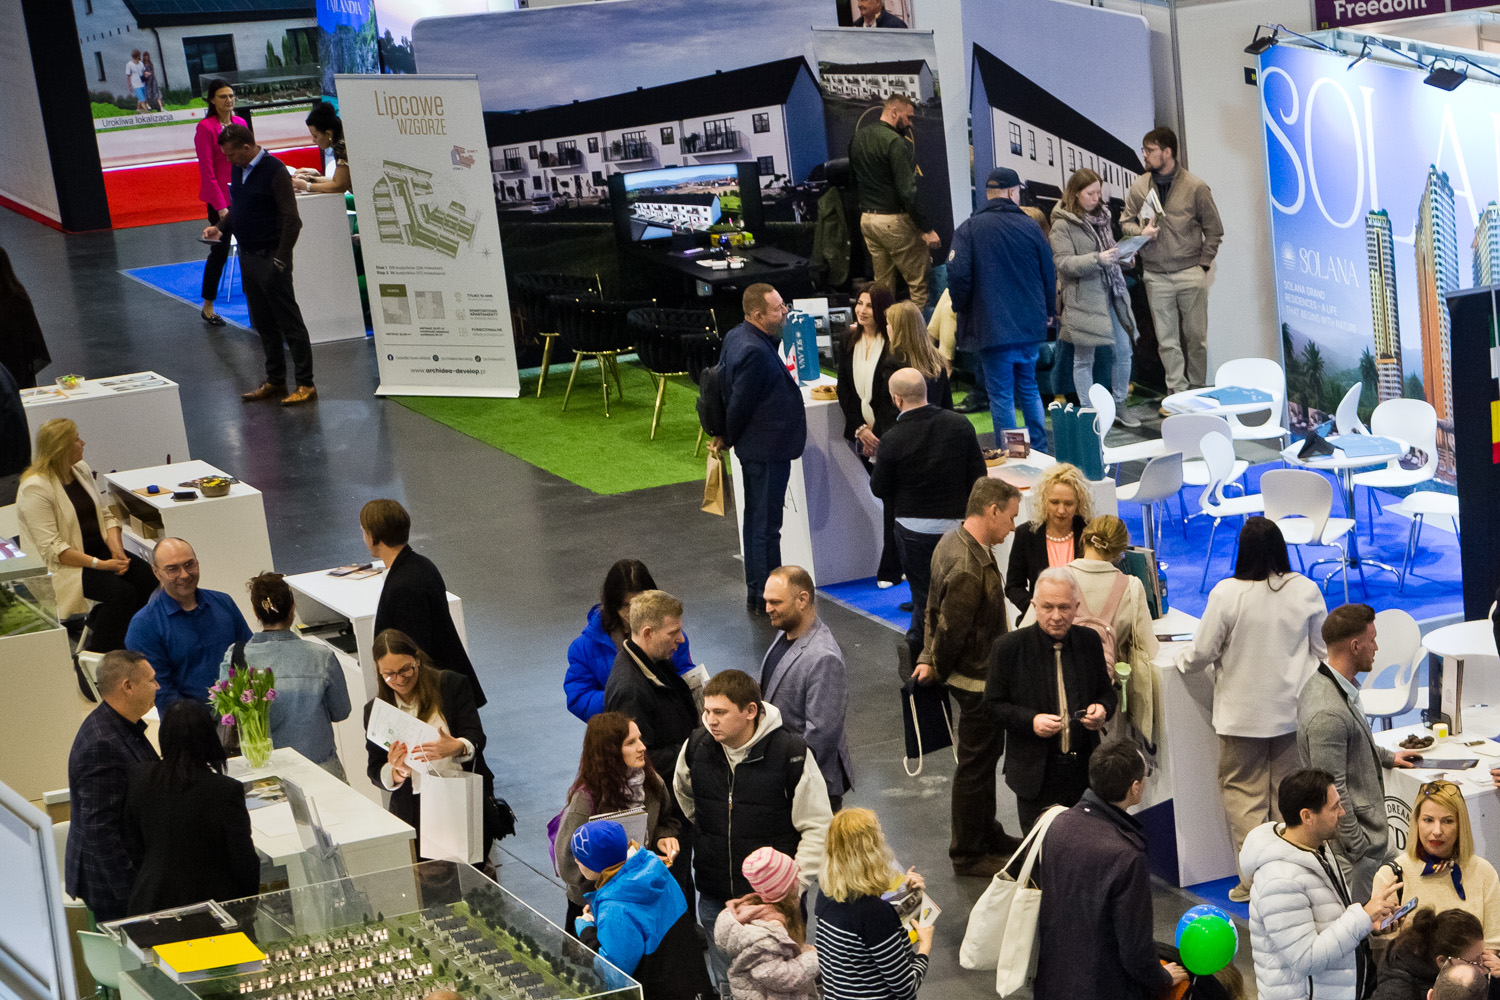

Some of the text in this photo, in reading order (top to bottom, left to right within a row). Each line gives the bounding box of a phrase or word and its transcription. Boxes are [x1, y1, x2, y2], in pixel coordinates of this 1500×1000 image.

[374, 90, 444, 119] Lipcowe
[102, 114, 174, 127] Urokliwa lokalizacja
[397, 116, 447, 135] WZGÓRZE
[1299, 247, 1359, 288] SOLANA
